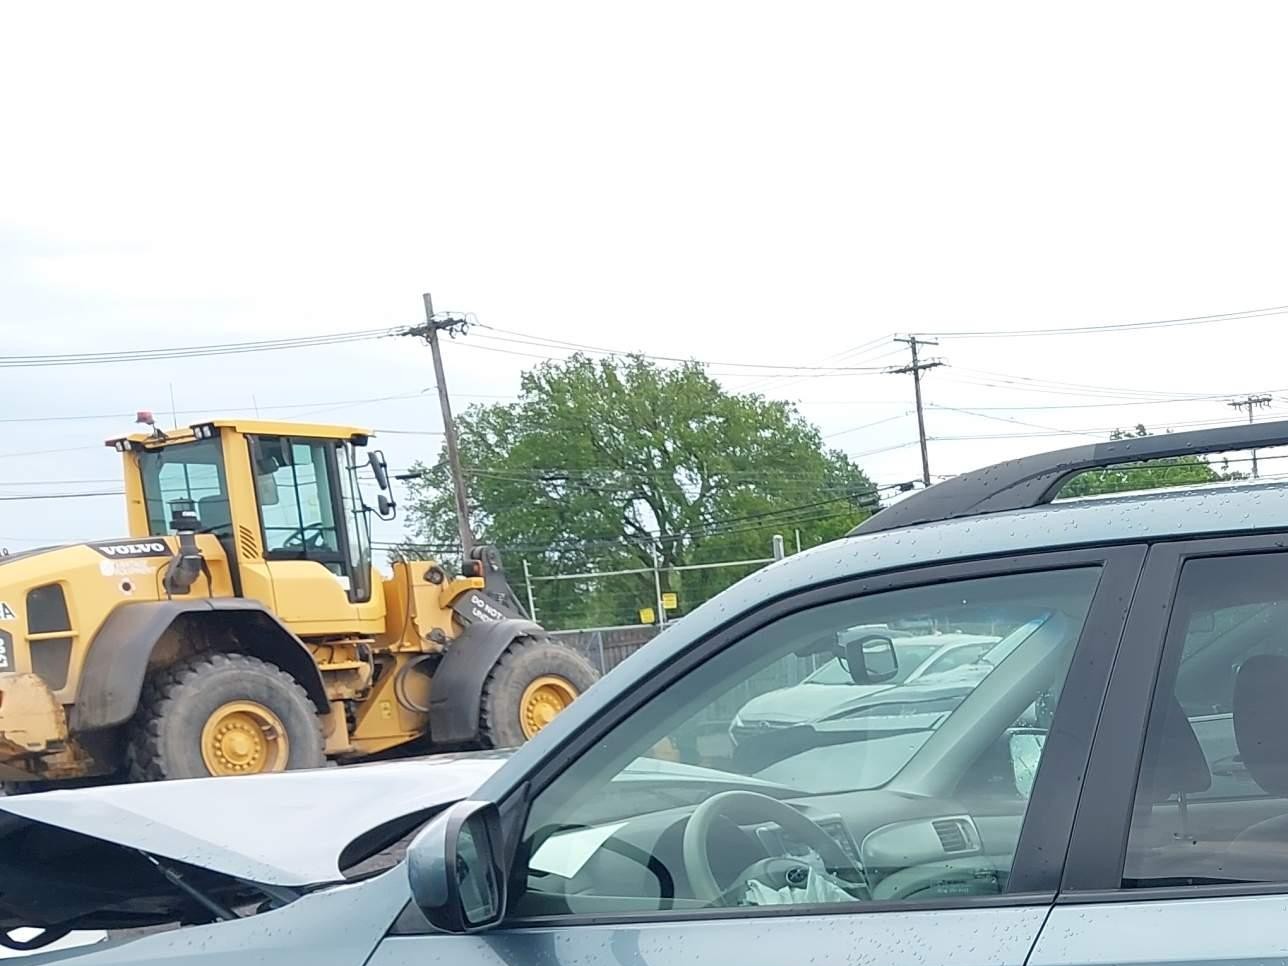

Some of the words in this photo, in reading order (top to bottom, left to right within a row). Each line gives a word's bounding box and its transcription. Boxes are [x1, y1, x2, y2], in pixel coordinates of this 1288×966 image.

[99, 542, 165, 556] VOLVO
[471, 594, 485, 608] DO
[484, 604, 504, 621] NOT
